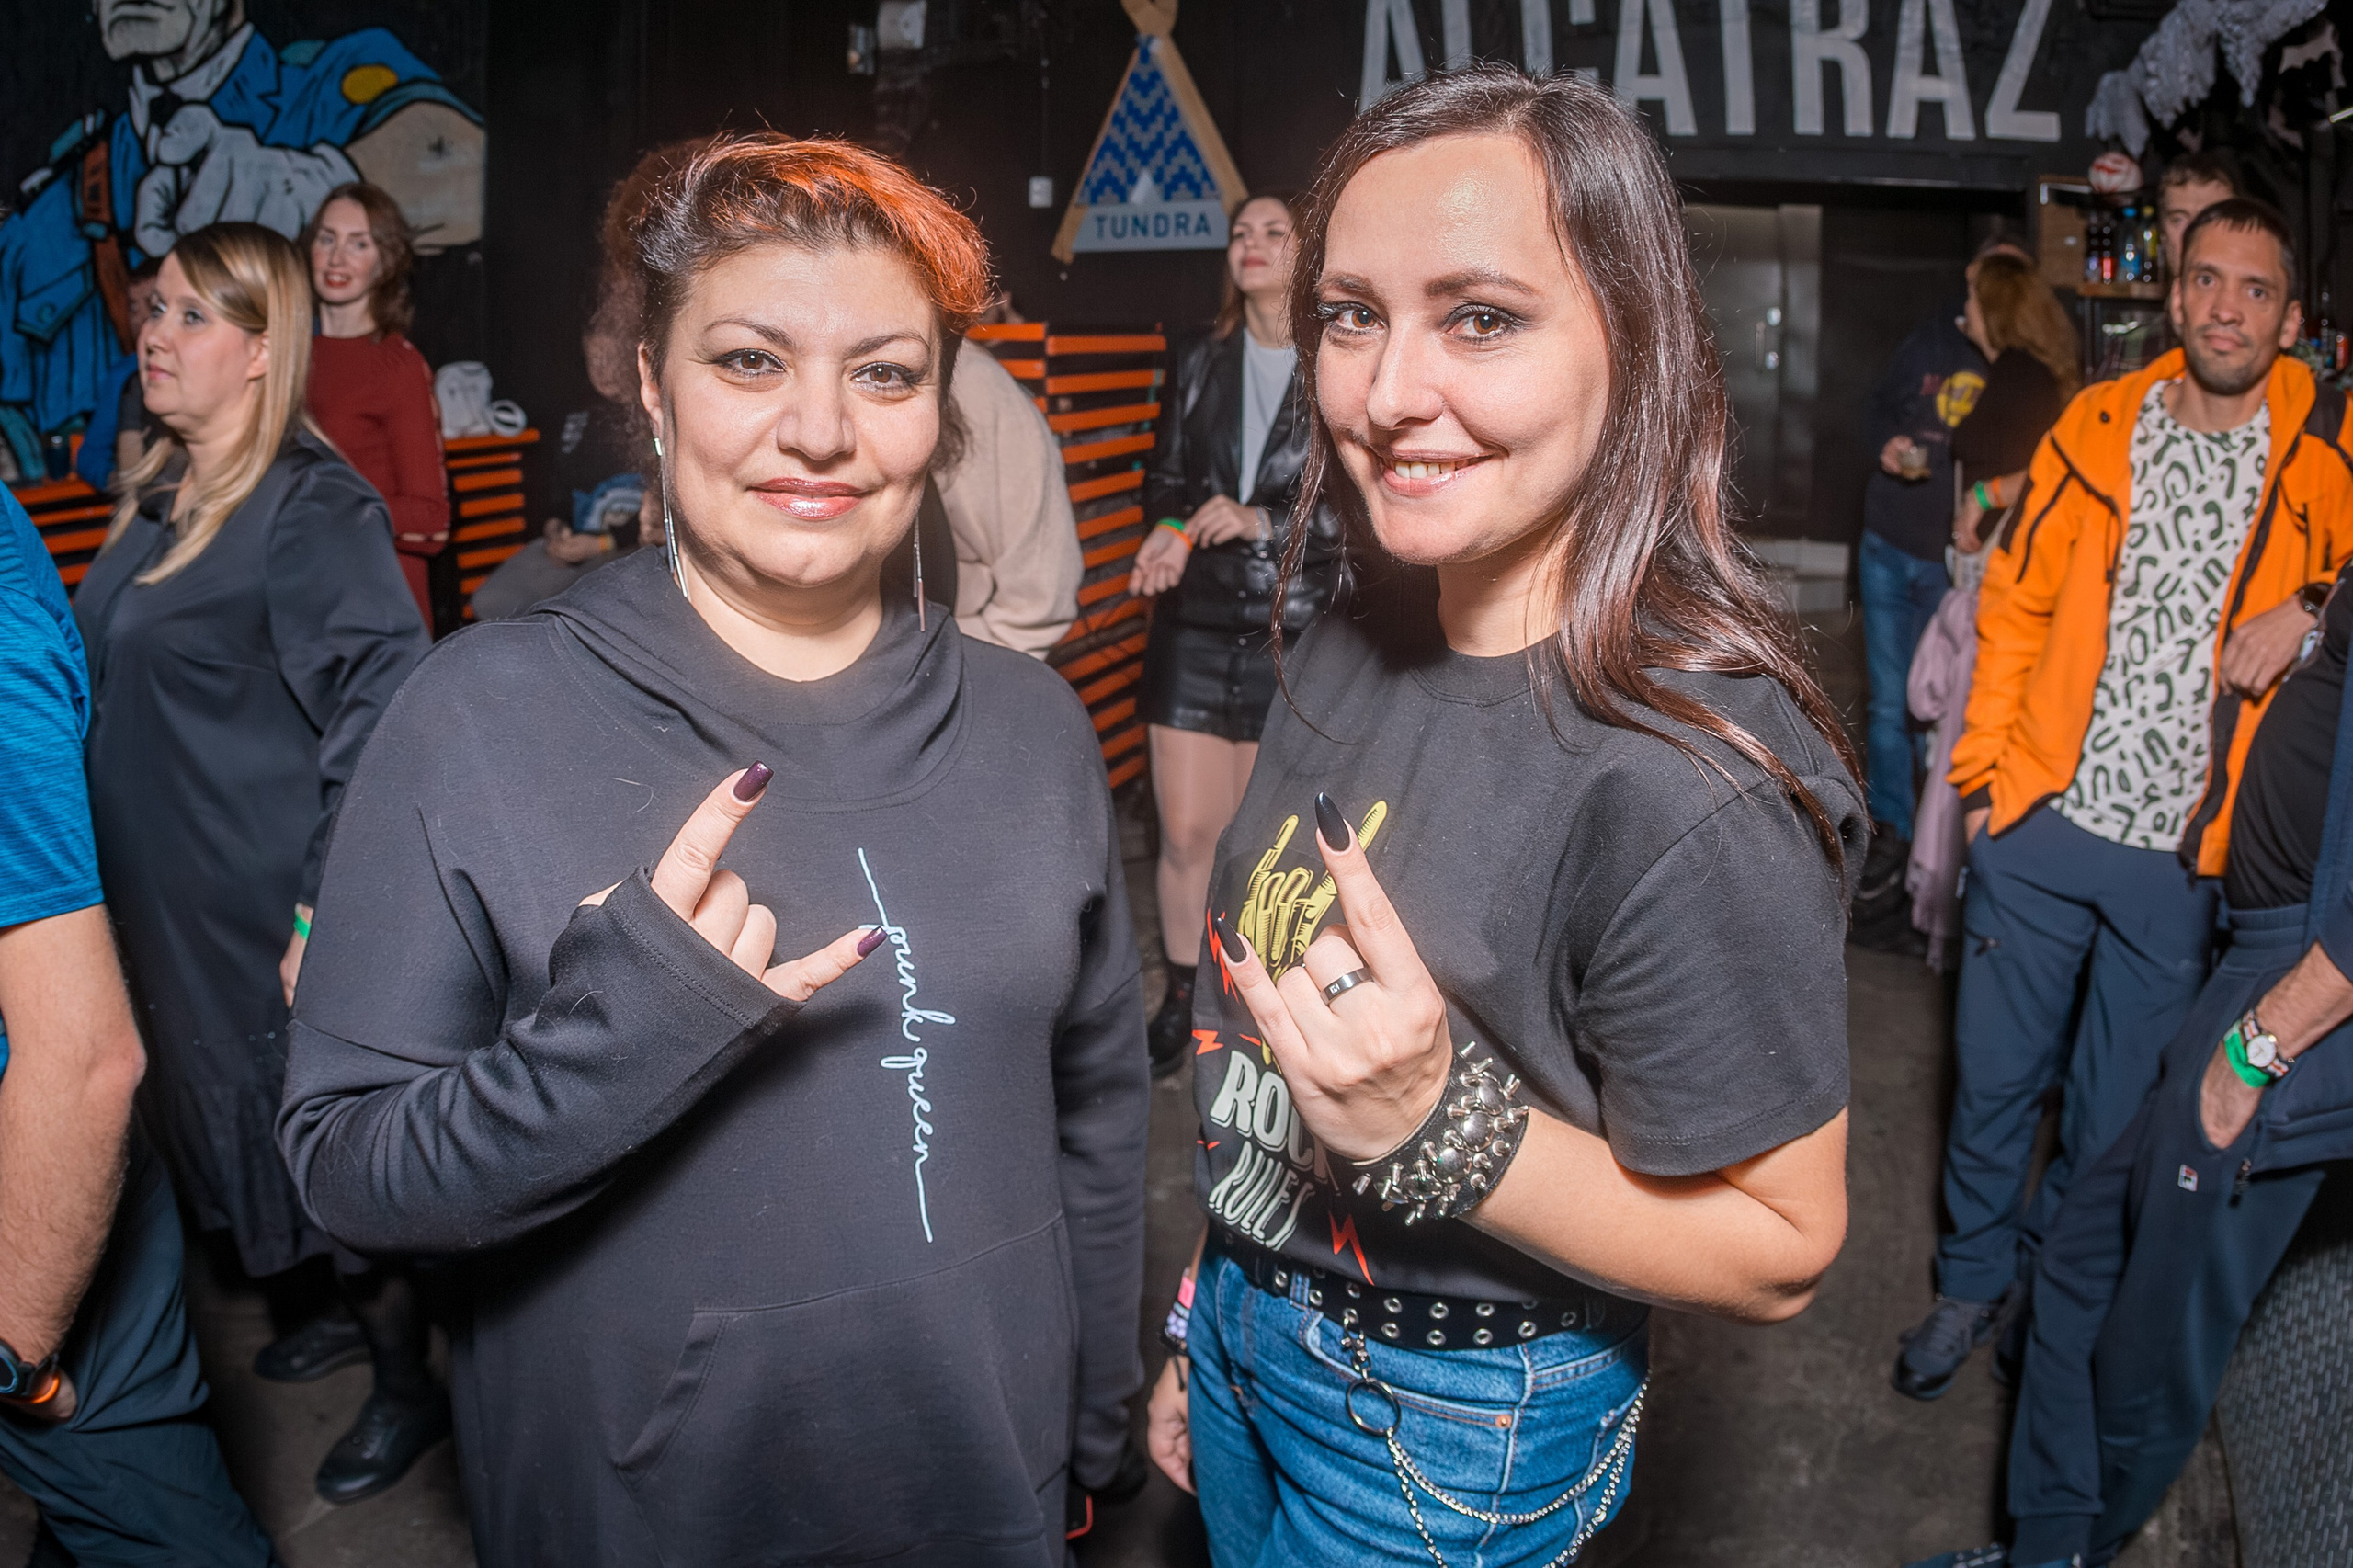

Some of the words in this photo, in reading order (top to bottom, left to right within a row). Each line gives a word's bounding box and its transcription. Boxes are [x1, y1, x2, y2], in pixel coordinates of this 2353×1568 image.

[1095, 211, 1212, 239] TUNDRA
[858, 847, 956, 1042] punk
[880, 1048, 934, 1244] queen
